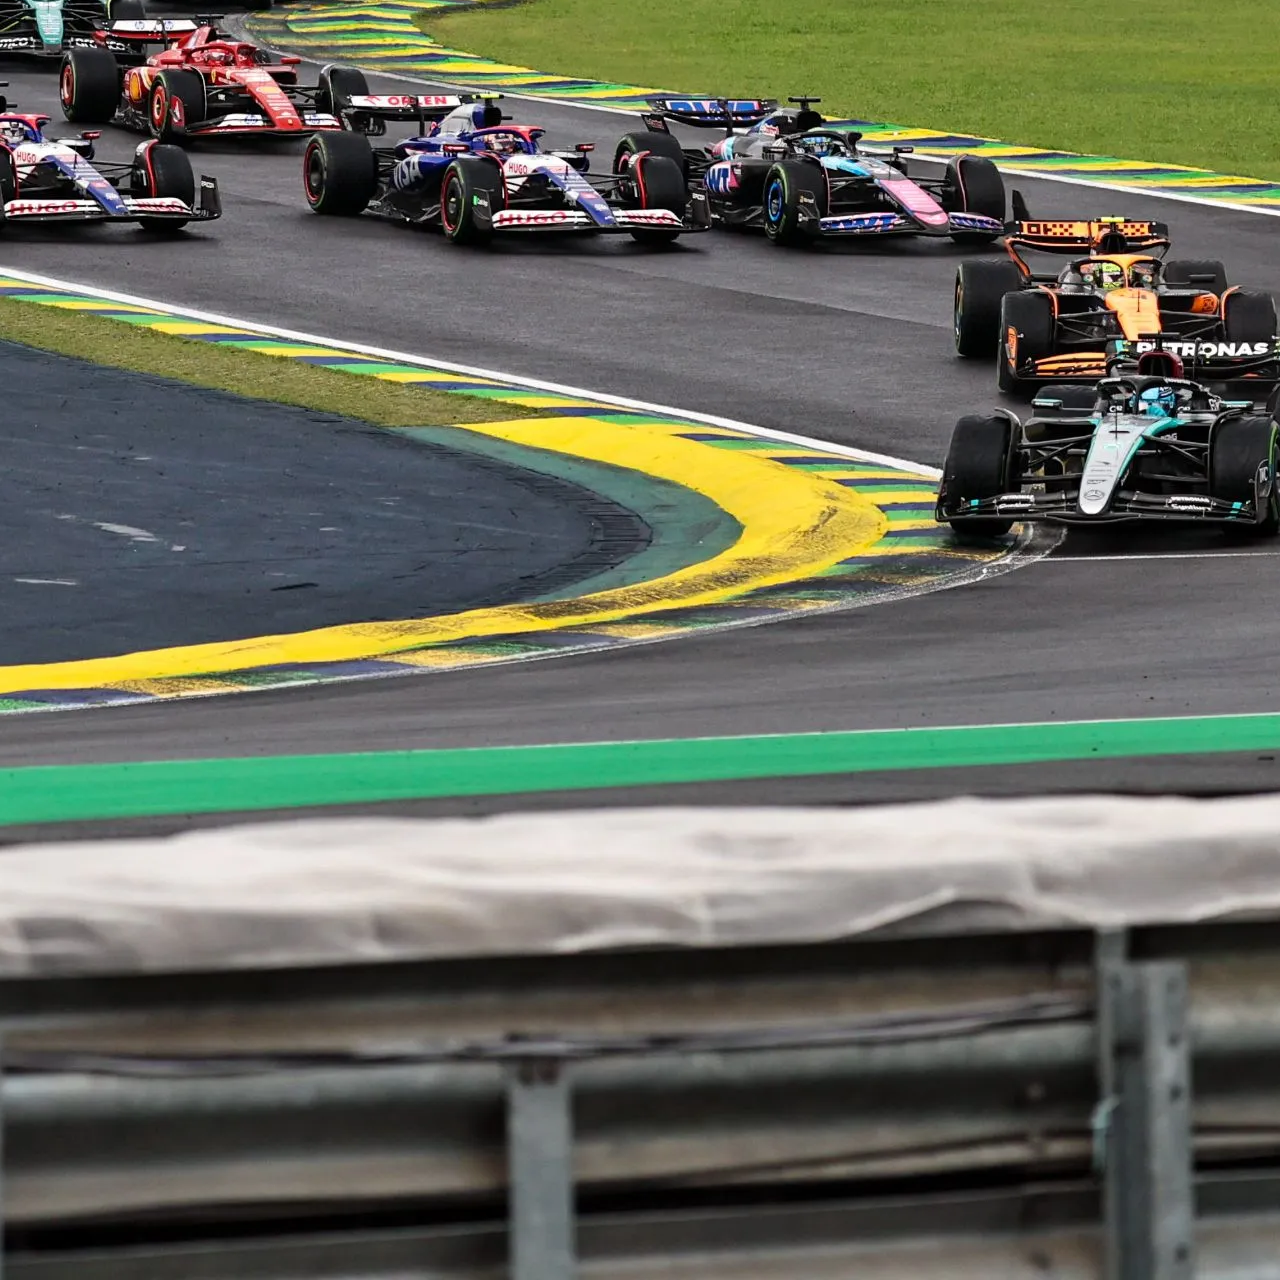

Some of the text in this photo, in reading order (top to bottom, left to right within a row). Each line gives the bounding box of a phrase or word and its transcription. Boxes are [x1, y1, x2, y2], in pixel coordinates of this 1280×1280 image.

[74, 37, 126, 51] araco
[387, 96, 448, 106] OREN
[16, 151, 37, 163] HUGO
[508, 163, 528, 175] HUGO
[10, 201, 78, 215] HUGO
[499, 211, 567, 224] HUGO
